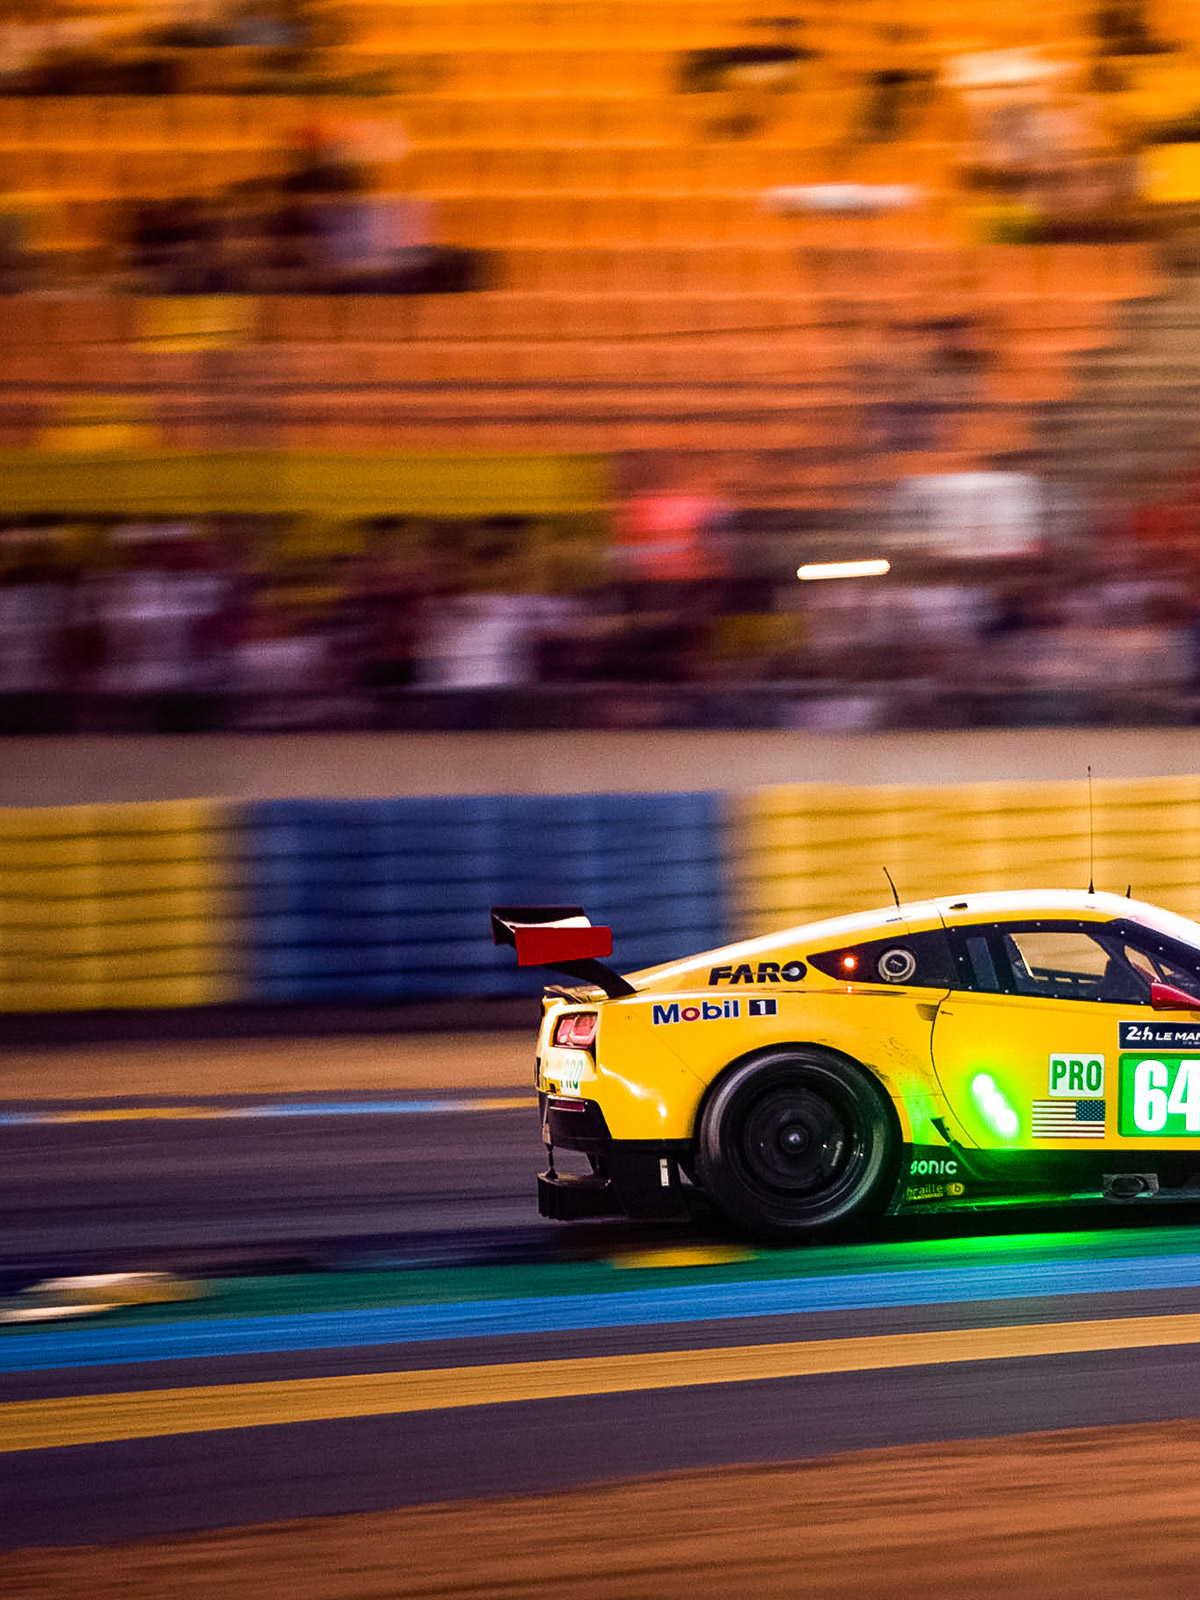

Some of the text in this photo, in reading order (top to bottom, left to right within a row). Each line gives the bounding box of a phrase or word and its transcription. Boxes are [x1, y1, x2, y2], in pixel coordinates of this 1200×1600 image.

[708, 960, 808, 986] FARO
[652, 1000, 740, 1025] Mobil
[1155, 1032, 1173, 1041] LE
[1051, 1060, 1102, 1091] PRO
